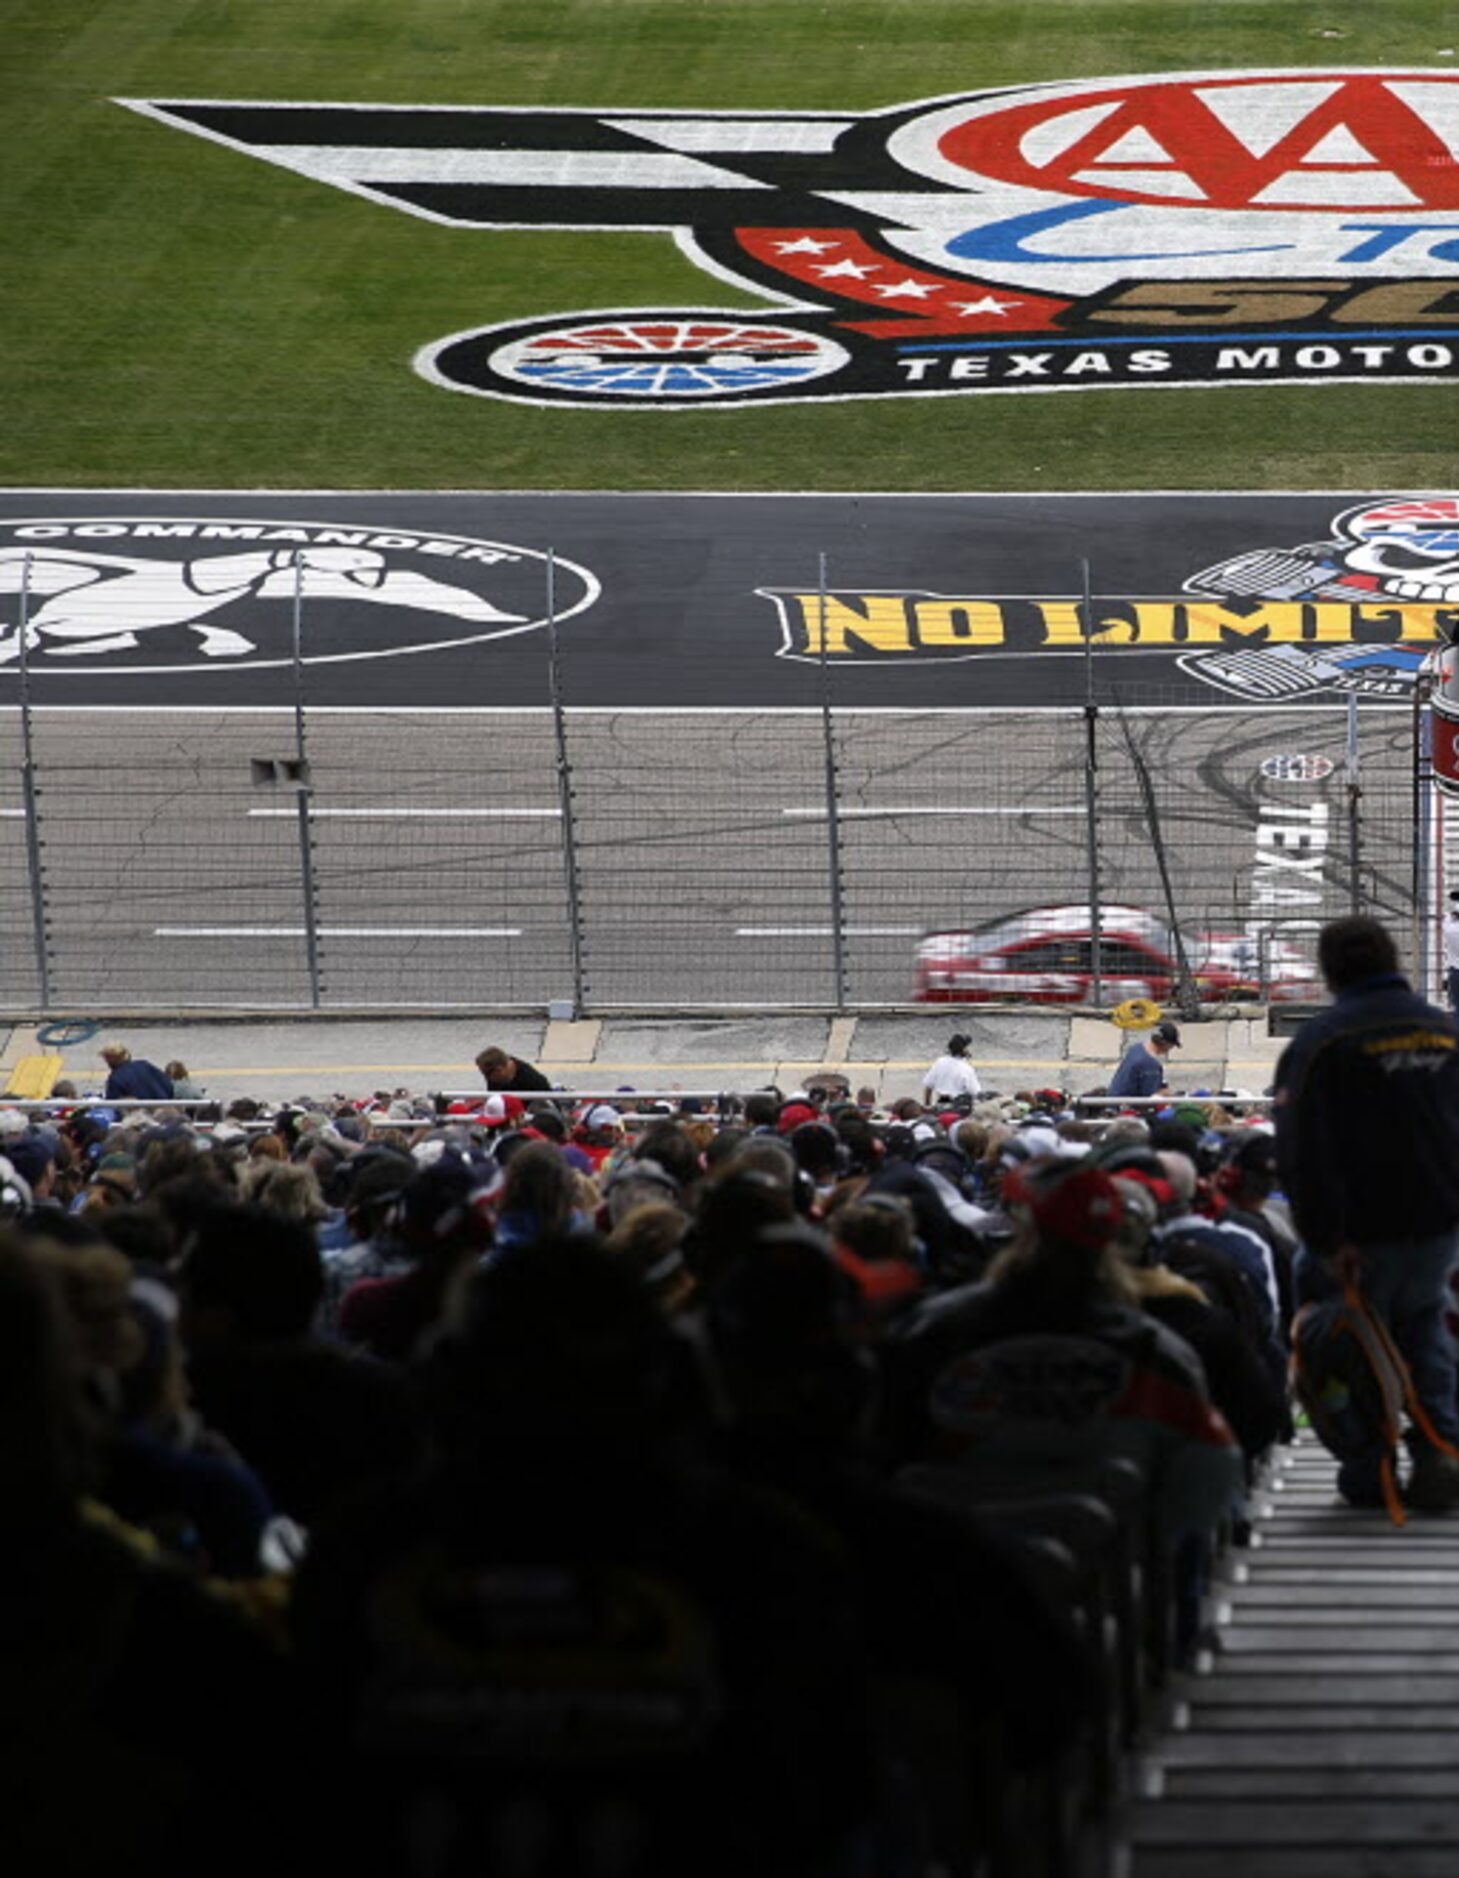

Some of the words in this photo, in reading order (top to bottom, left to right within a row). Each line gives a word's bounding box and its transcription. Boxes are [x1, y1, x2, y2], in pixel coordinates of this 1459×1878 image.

[898, 349, 1172, 381] TEXAS
[13, 523, 507, 565] COMMANDER
[795, 595, 1005, 653] NO
